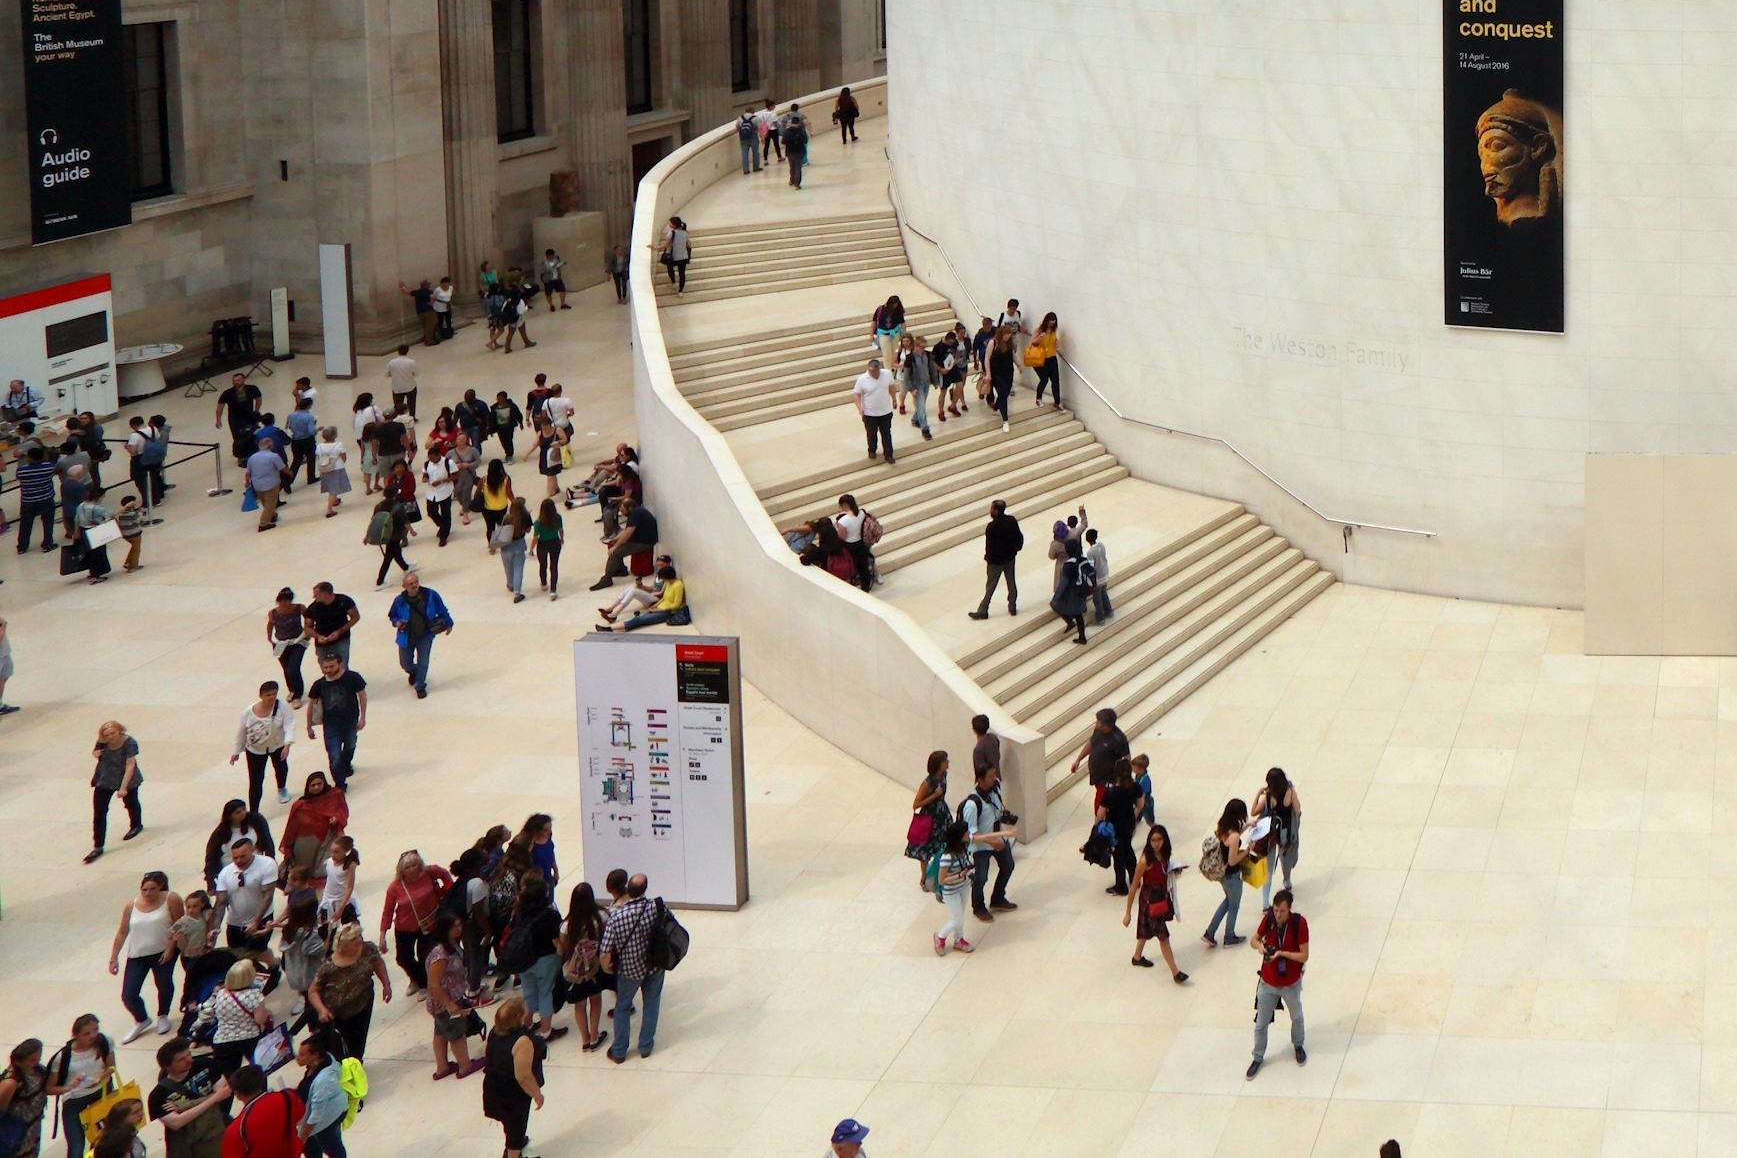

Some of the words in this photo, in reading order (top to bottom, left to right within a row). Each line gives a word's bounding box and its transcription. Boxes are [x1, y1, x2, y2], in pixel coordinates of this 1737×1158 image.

[32, 3, 78, 12] Sculpture.
[33, 13, 67, 22] Ancient
[69, 10, 95, 20] Egypt.
[1459, 21, 1553, 40] conquest
[34, 33, 52, 42] The
[34, 41, 64, 52] British
[66, 38, 103, 49] Museum
[35, 52, 55, 63] your
[58, 51, 75, 60] way
[1469, 53, 1485, 61] April
[1468, 62, 1491, 70] August
[41, 148, 90, 168] Audio
[42, 166, 90, 188] guide
[1232, 326, 1263, 350] The
[1269, 331, 1337, 361] Weston
[1346, 341, 1409, 373] Family
